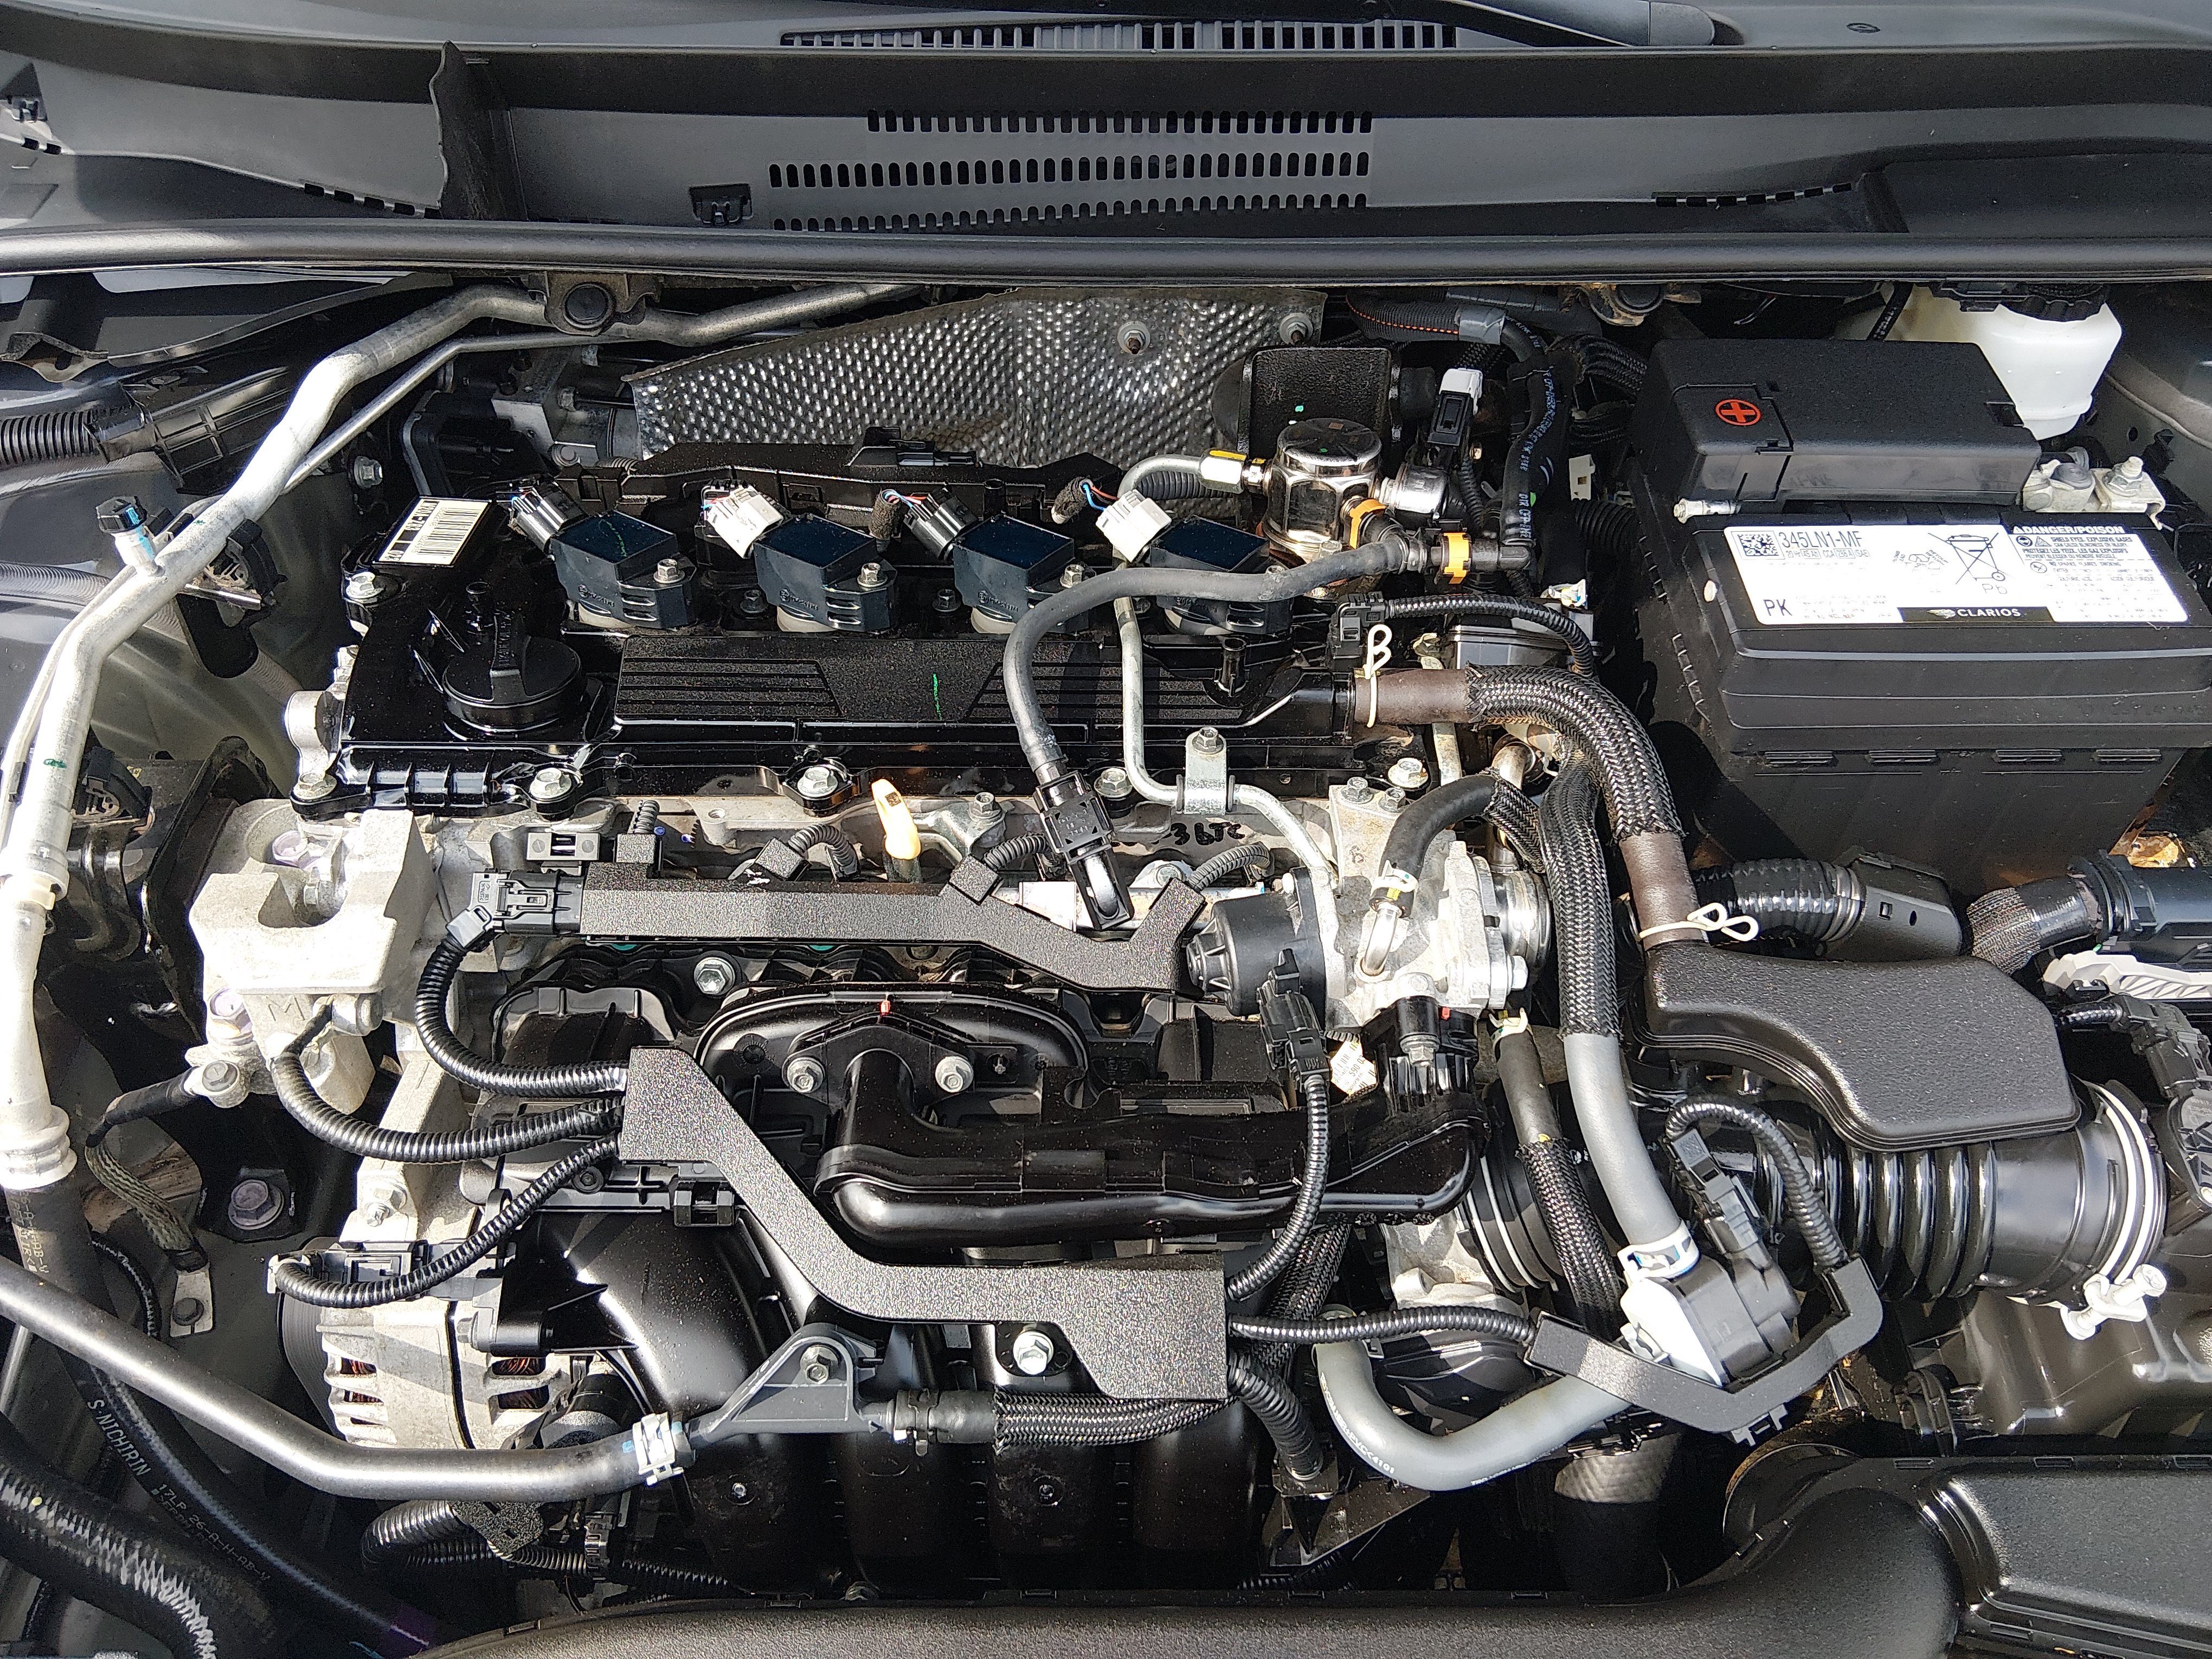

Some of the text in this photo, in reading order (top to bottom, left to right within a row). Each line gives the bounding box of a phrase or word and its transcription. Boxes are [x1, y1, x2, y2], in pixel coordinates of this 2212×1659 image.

[2021, 526, 2125, 534] DANGER/POISON
[1779, 531, 1862, 548] 345LN1-MF
[1982, 583, 2008, 594] Pb
[1763, 599, 1793, 616] PK
[1957, 608, 2021, 618] CLARIOS
